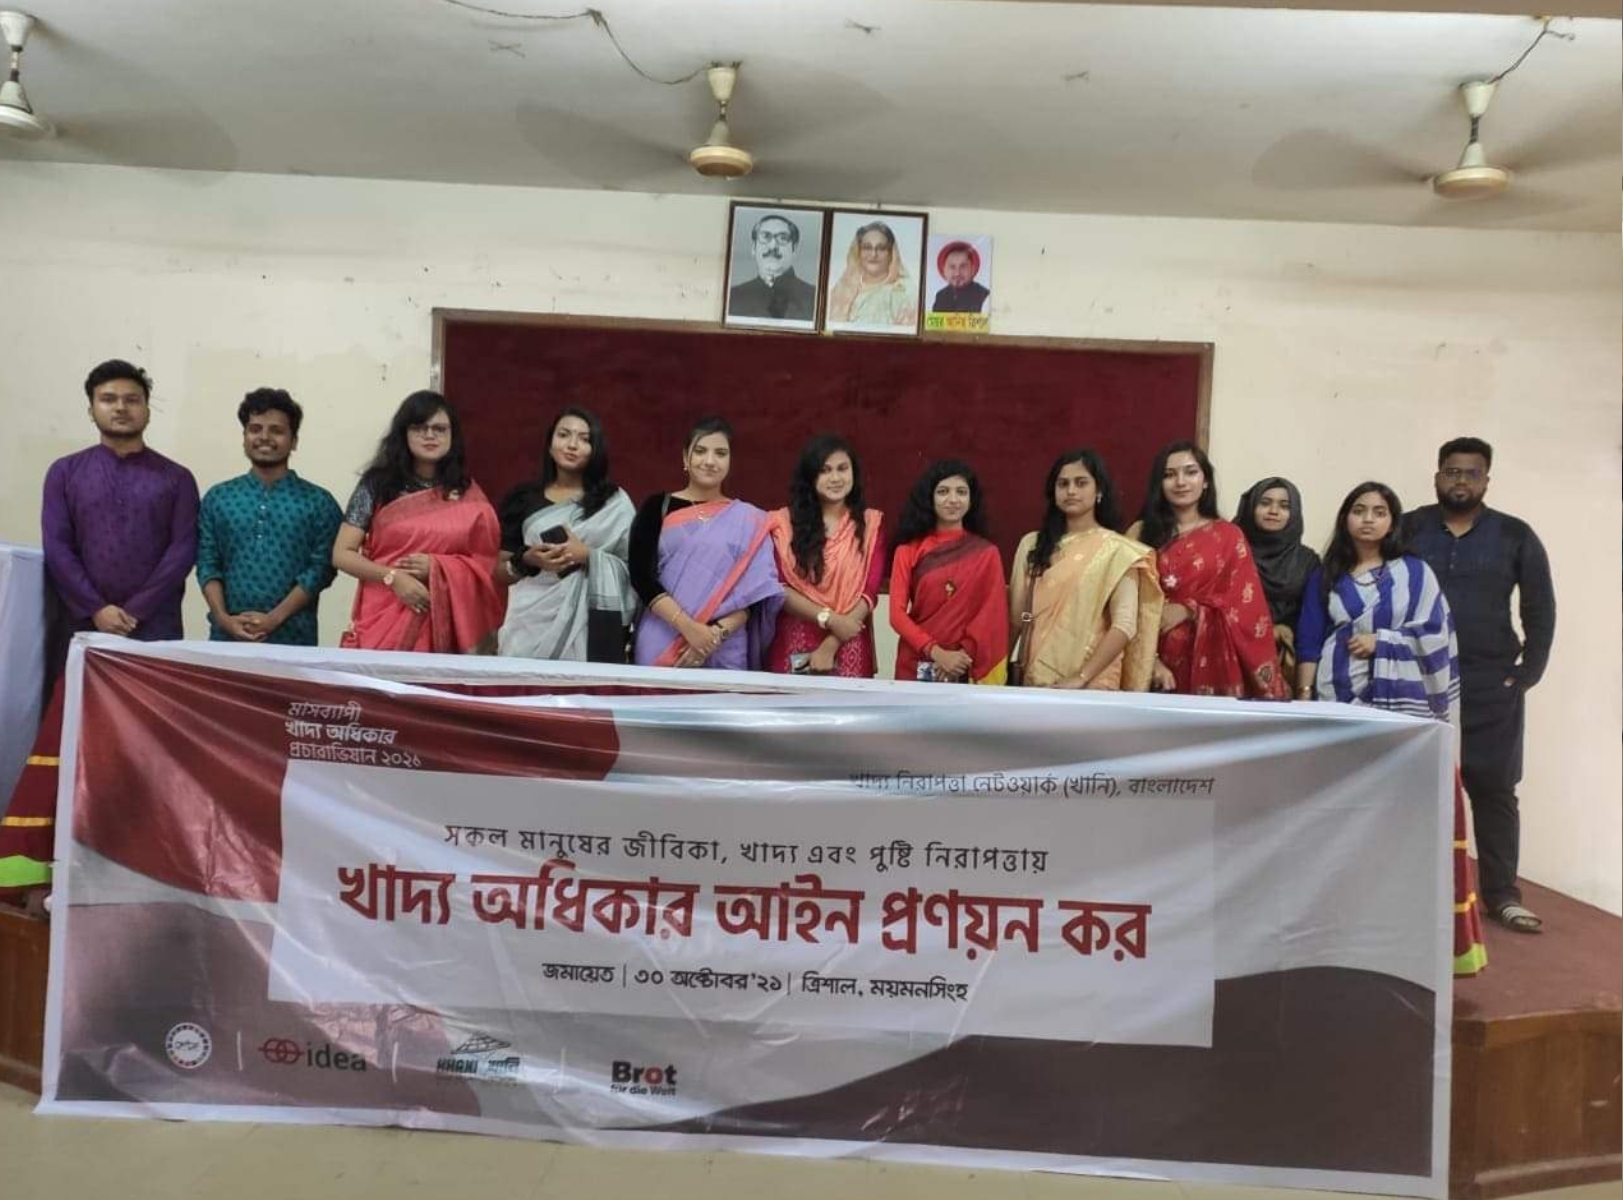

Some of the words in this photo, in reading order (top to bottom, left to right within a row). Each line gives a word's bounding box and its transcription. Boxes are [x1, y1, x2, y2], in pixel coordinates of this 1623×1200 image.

[288, 701, 361, 720] মাসব্যাপী
[284, 720, 323, 739] খাদ্য
[326, 721, 399, 744] অধিকার
[289, 742, 376, 763] প্রচারাভিযান
[896, 770, 966, 793] নিরাপত্তা
[973, 773, 1058, 796] নেটওয়ার্ক
[1128, 778, 1215, 795] বাংলাদেশ
[445, 825, 508, 848] সকল
[518, 830, 611, 859] মানুষের
[622, 830, 728, 864] জীবিকা,
[740, 842, 799, 864] খাদ্য
[808, 845, 857, 865] এবং
[869, 840, 914, 873] পুষ্টি
[924, 841, 1050, 875] নিরাপত্তায়
[337, 862, 457, 926] খাদ্য
[471, 859, 701, 941] অধিকার
[713, 874, 866, 945] আইন
[881, 886, 1044, 961] প্রণয়ন
[1058, 899, 1153, 963] কর
[541, 963, 616, 984] জমায়েত
[634, 969, 664, 985] ৩০
[869, 975, 969, 1002] ময়মনসিংহ
[306, 1041, 368, 1073] idea
[611, 1061, 678, 1086] Brot
